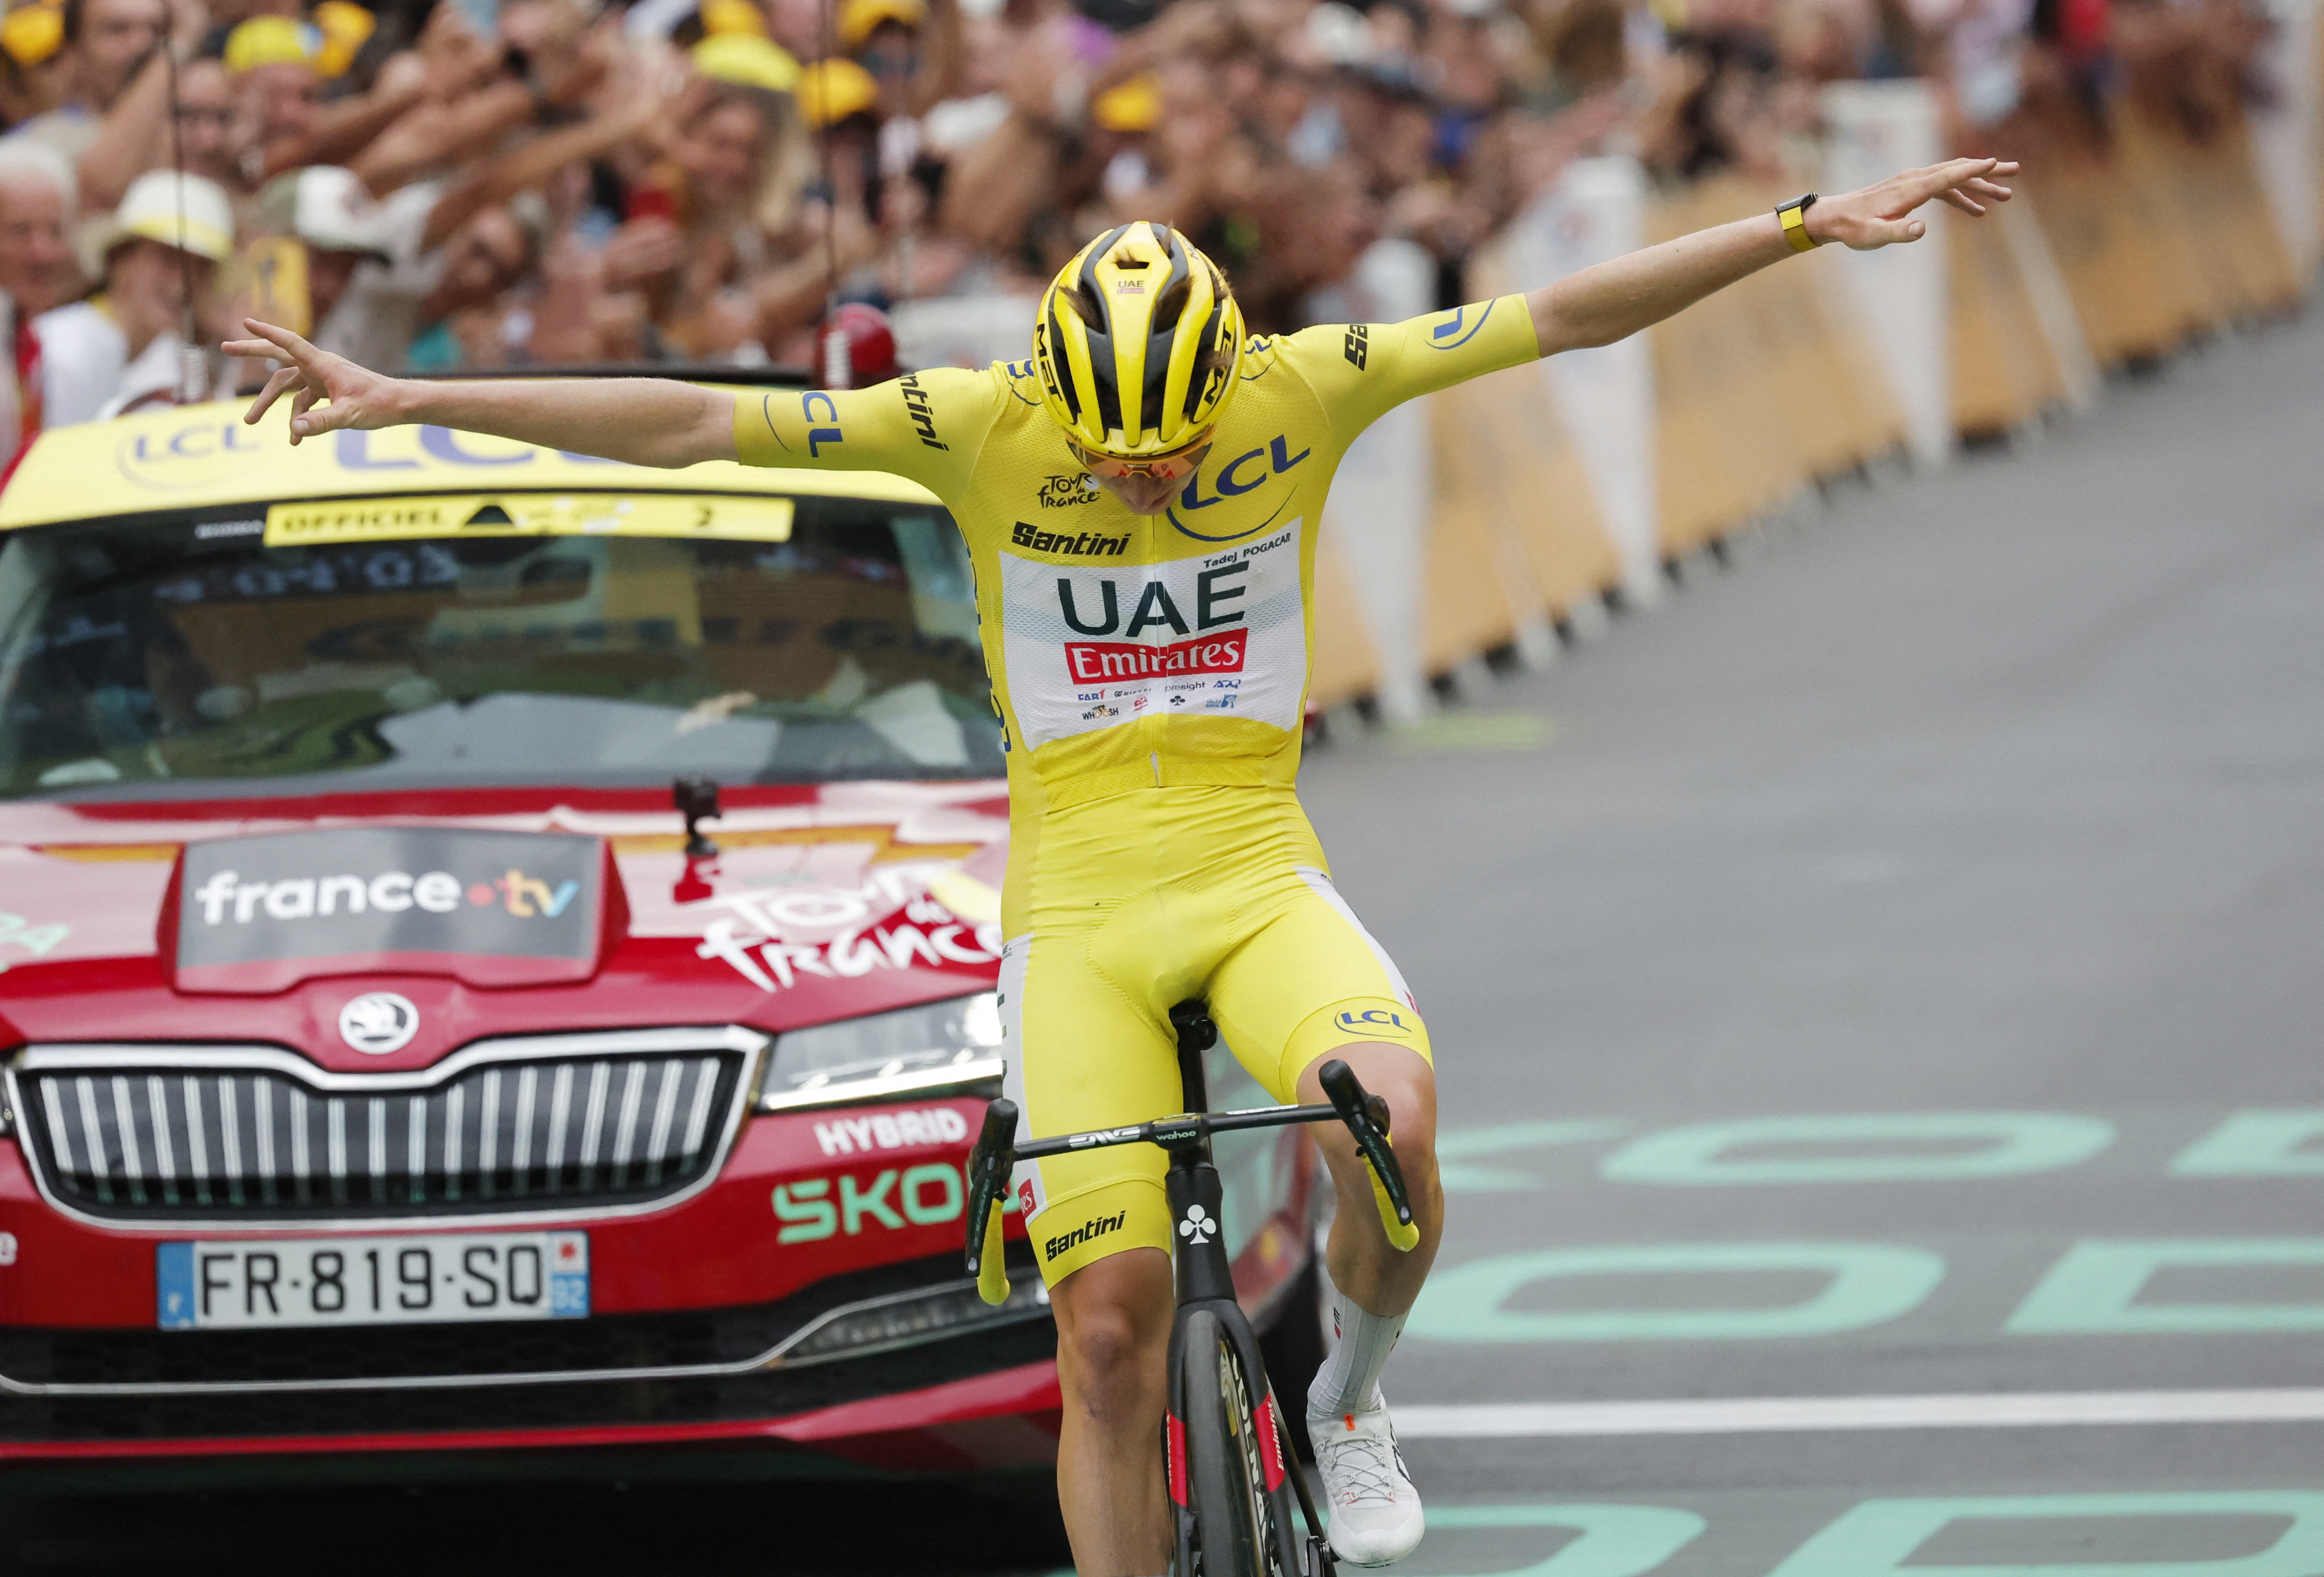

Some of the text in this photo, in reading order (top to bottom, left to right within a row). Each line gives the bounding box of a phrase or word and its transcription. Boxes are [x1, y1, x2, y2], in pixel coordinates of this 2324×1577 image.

[1037, 323, 1063, 402] MET
[1345, 324, 1368, 371] Sa
[134, 425, 260, 461] LCL
[799, 391, 843, 458] CL
[1182, 434, 1310, 510] LCL
[282, 506, 444, 532] OFFICIEL
[1012, 521, 1132, 556] Santini
[1243, 533, 1291, 557] POGACAR
[1057, 560, 1249, 637] UAE
[1071, 641, 1240, 678] Emirates
[195, 870, 463, 926] france
[1340, 1010, 1412, 1033] LCL
[813, 1108, 968, 1156] HYBRID
[1156, 1130, 1197, 1141] wahoo
[1045, 1210, 1126, 1262] Santini
